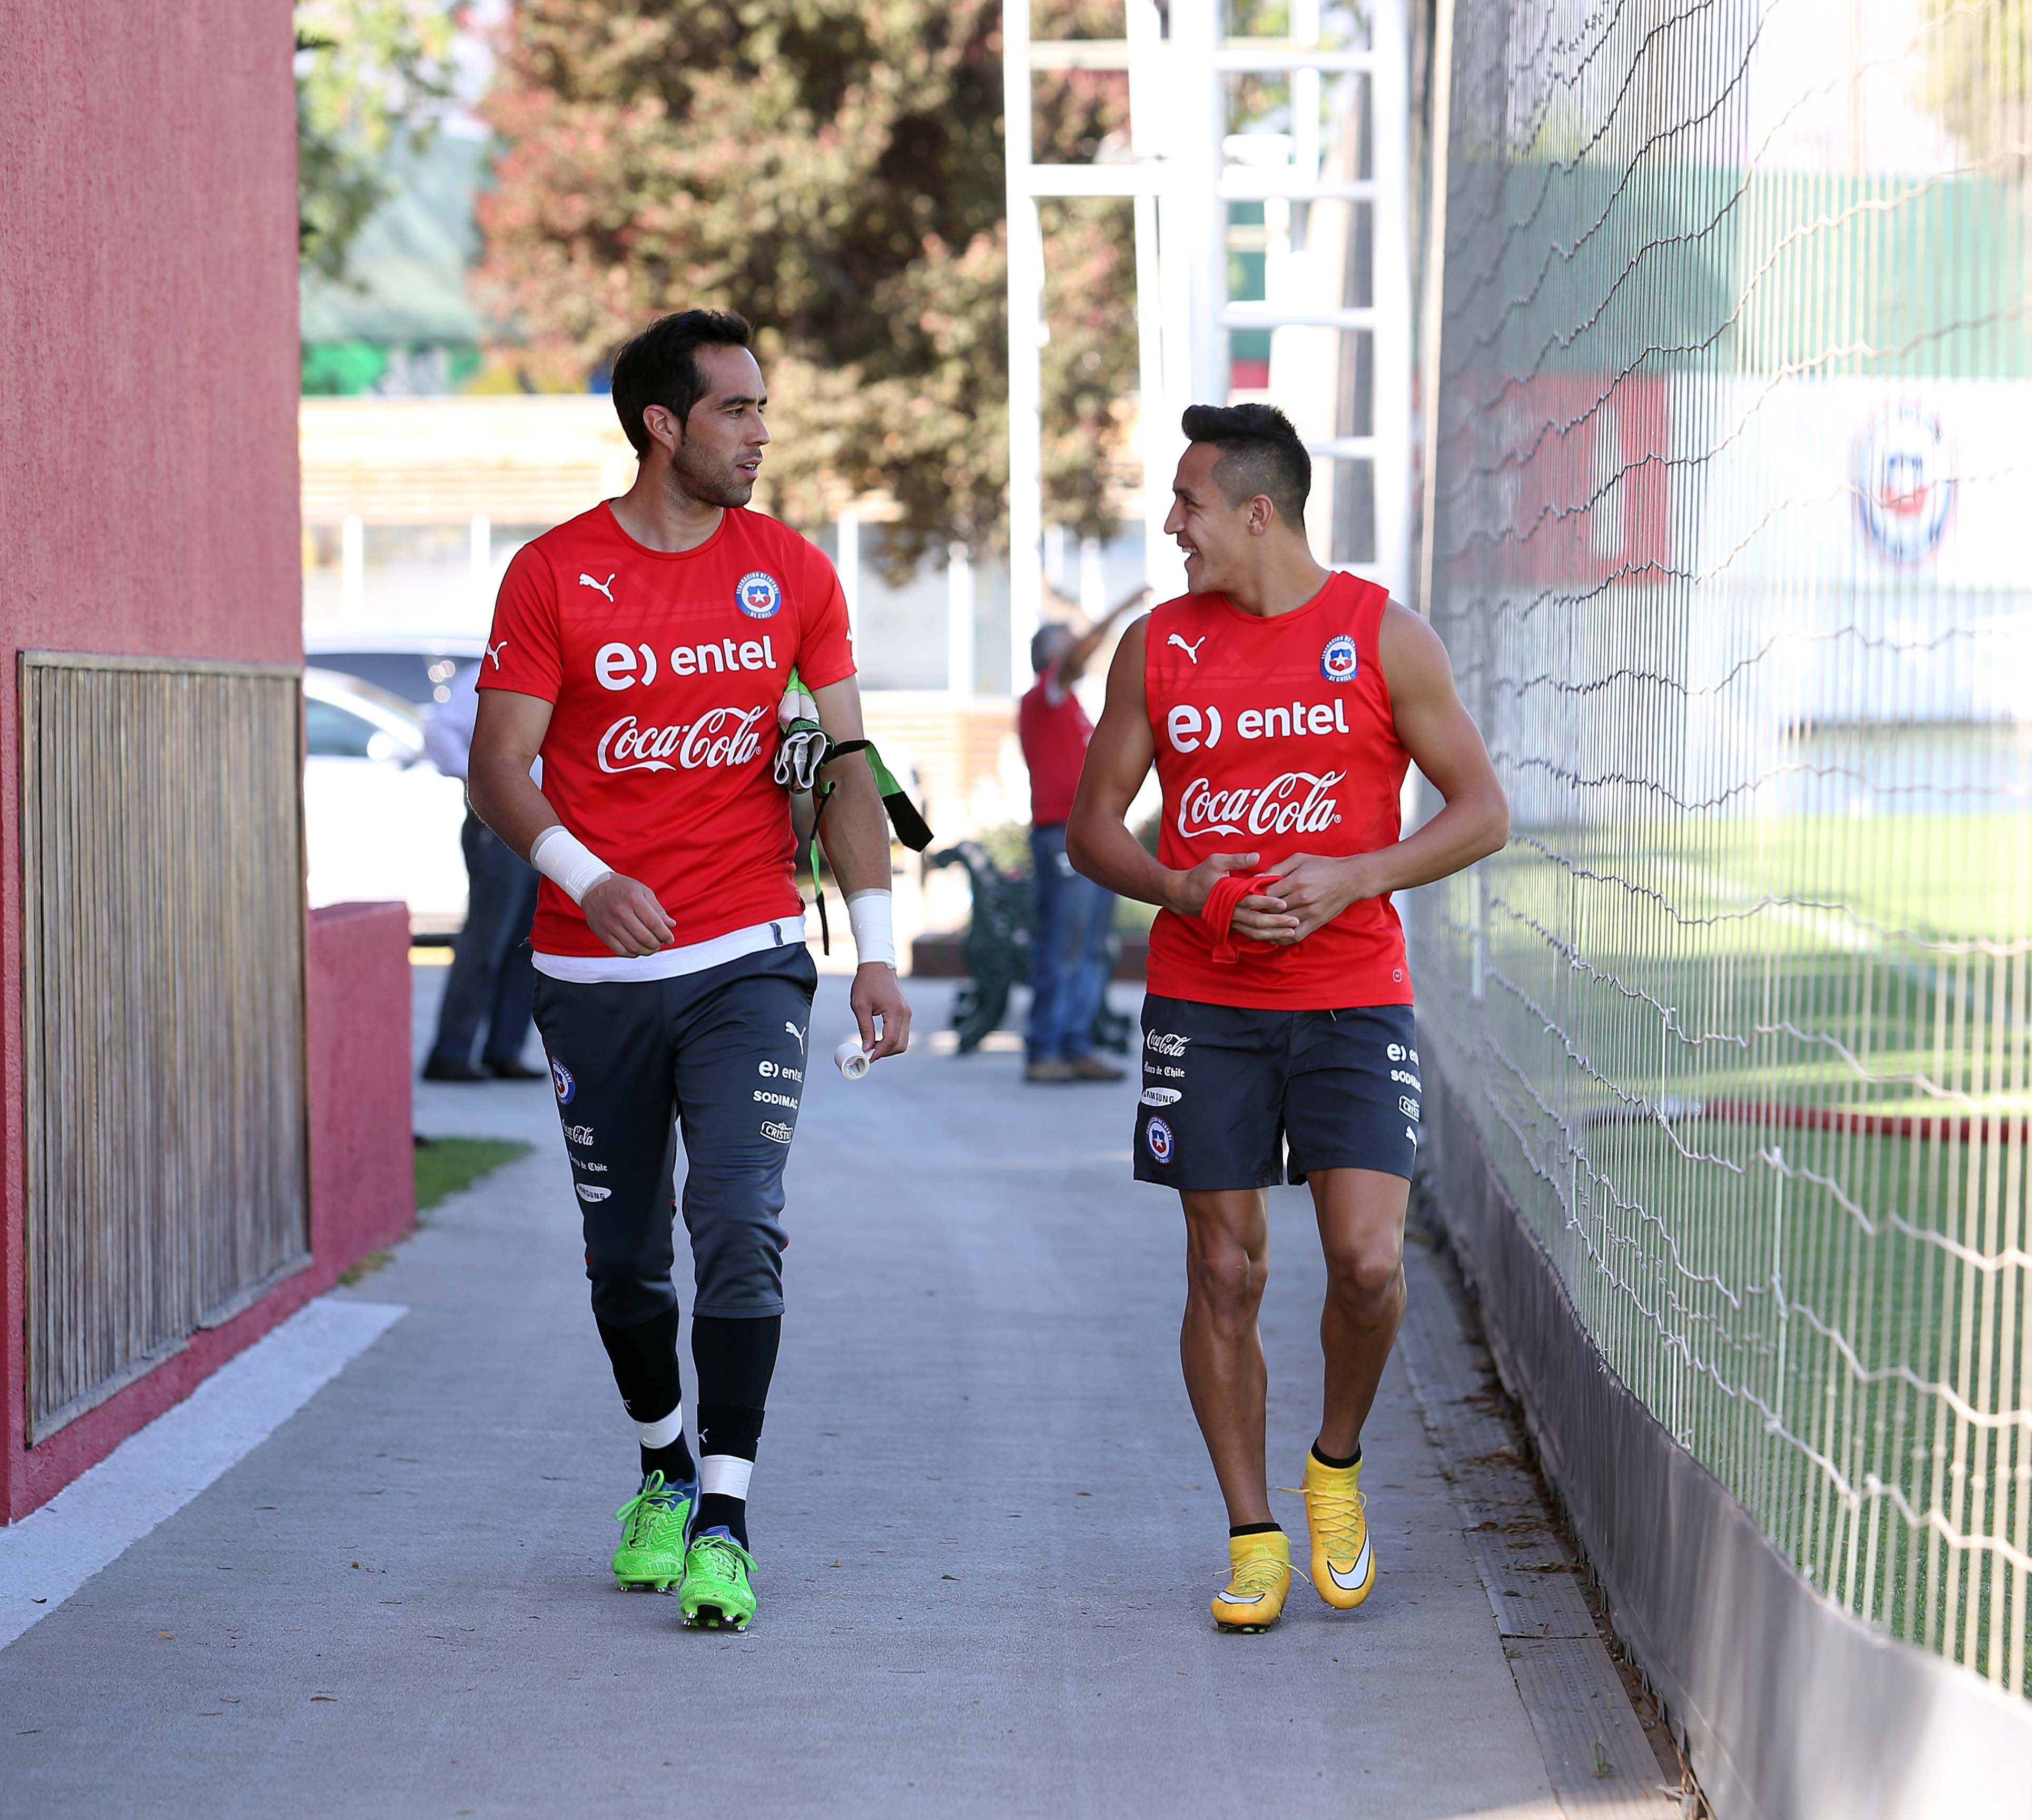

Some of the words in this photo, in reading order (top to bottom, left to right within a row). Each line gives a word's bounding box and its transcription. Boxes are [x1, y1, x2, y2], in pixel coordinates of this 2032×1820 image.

[670, 635, 776, 676] entel
[1237, 698, 1350, 739] entel
[597, 705, 770, 774] Coca-Cola
[1178, 770, 1347, 838] Coca-Cola
[1164, 1066, 1185, 1078] Chile
[753, 1090, 798, 1110] SODIMAC
[1143, 1091, 1175, 1103] SAMSUNG
[588, 1162, 608, 1172] Chile
